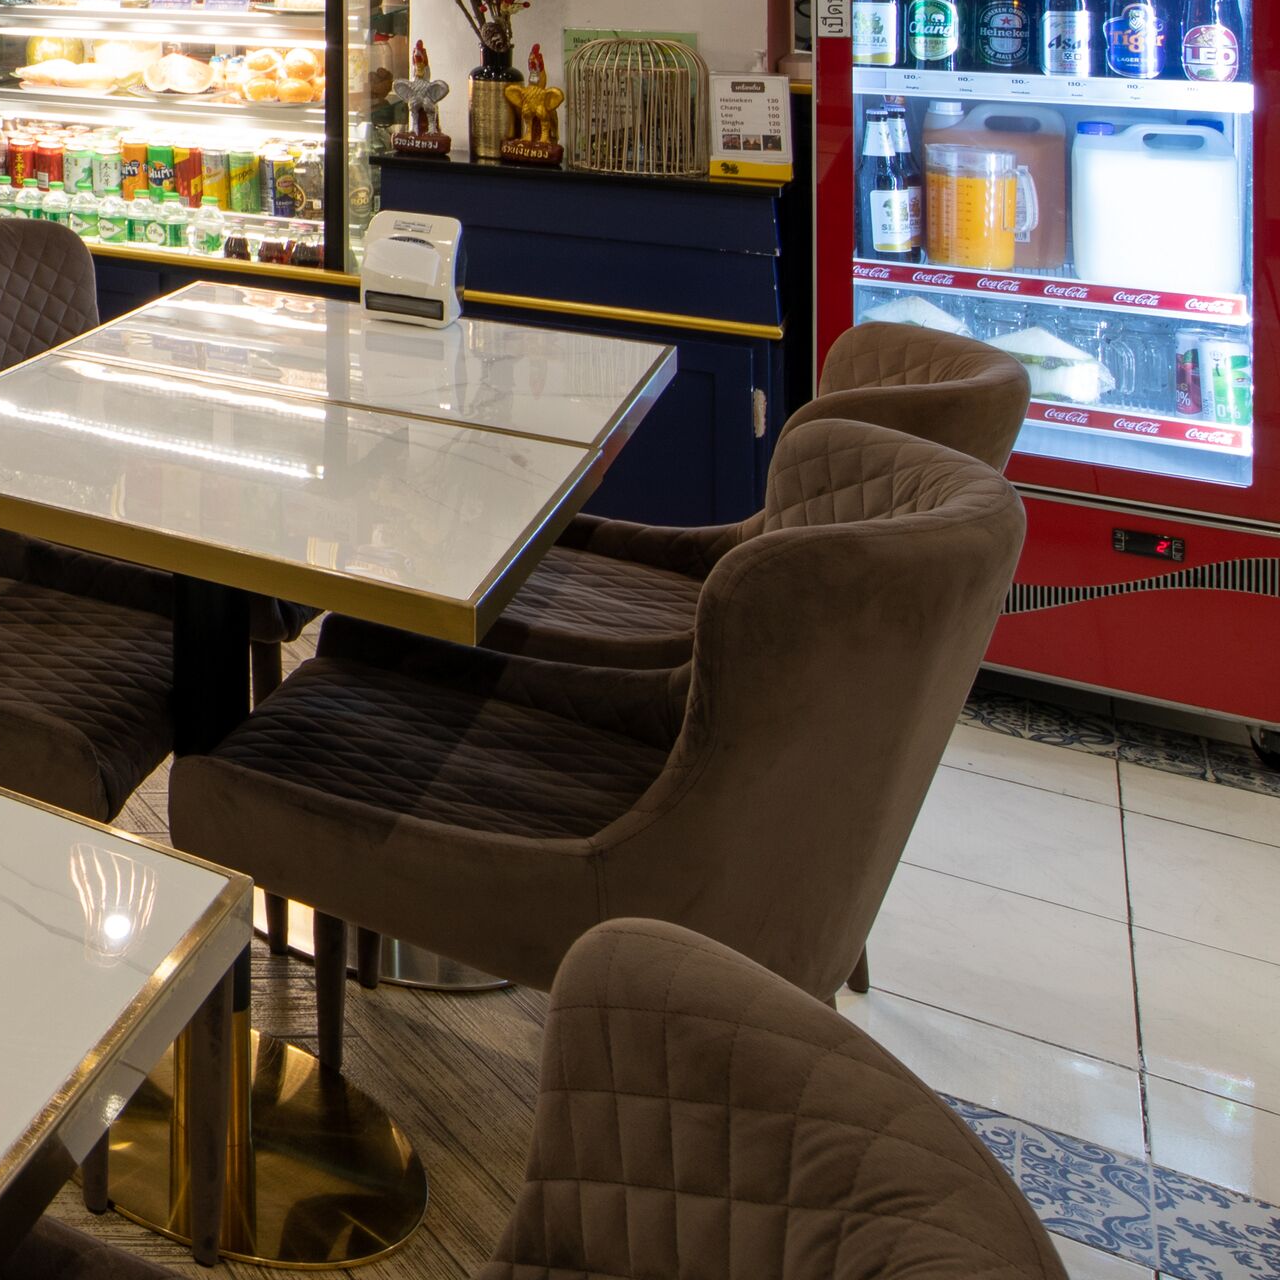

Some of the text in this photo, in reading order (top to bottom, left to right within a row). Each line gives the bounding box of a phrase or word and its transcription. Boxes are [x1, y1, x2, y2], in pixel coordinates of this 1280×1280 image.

[909, 21, 954, 37] Chang
[979, 27, 1030, 37] Heineken
[1186, 47, 1236, 60] LEO
[912, 271, 954, 286] Coca-Cola
[976, 277, 1021, 292] Coca-Cola
[1043, 285, 1089, 299] Coca-Cola
[1113, 291, 1161, 306] Coca-Cola
[1044, 408, 1089, 424] Coca-Cola
[1113, 418, 1161, 434] Coca-Cola
